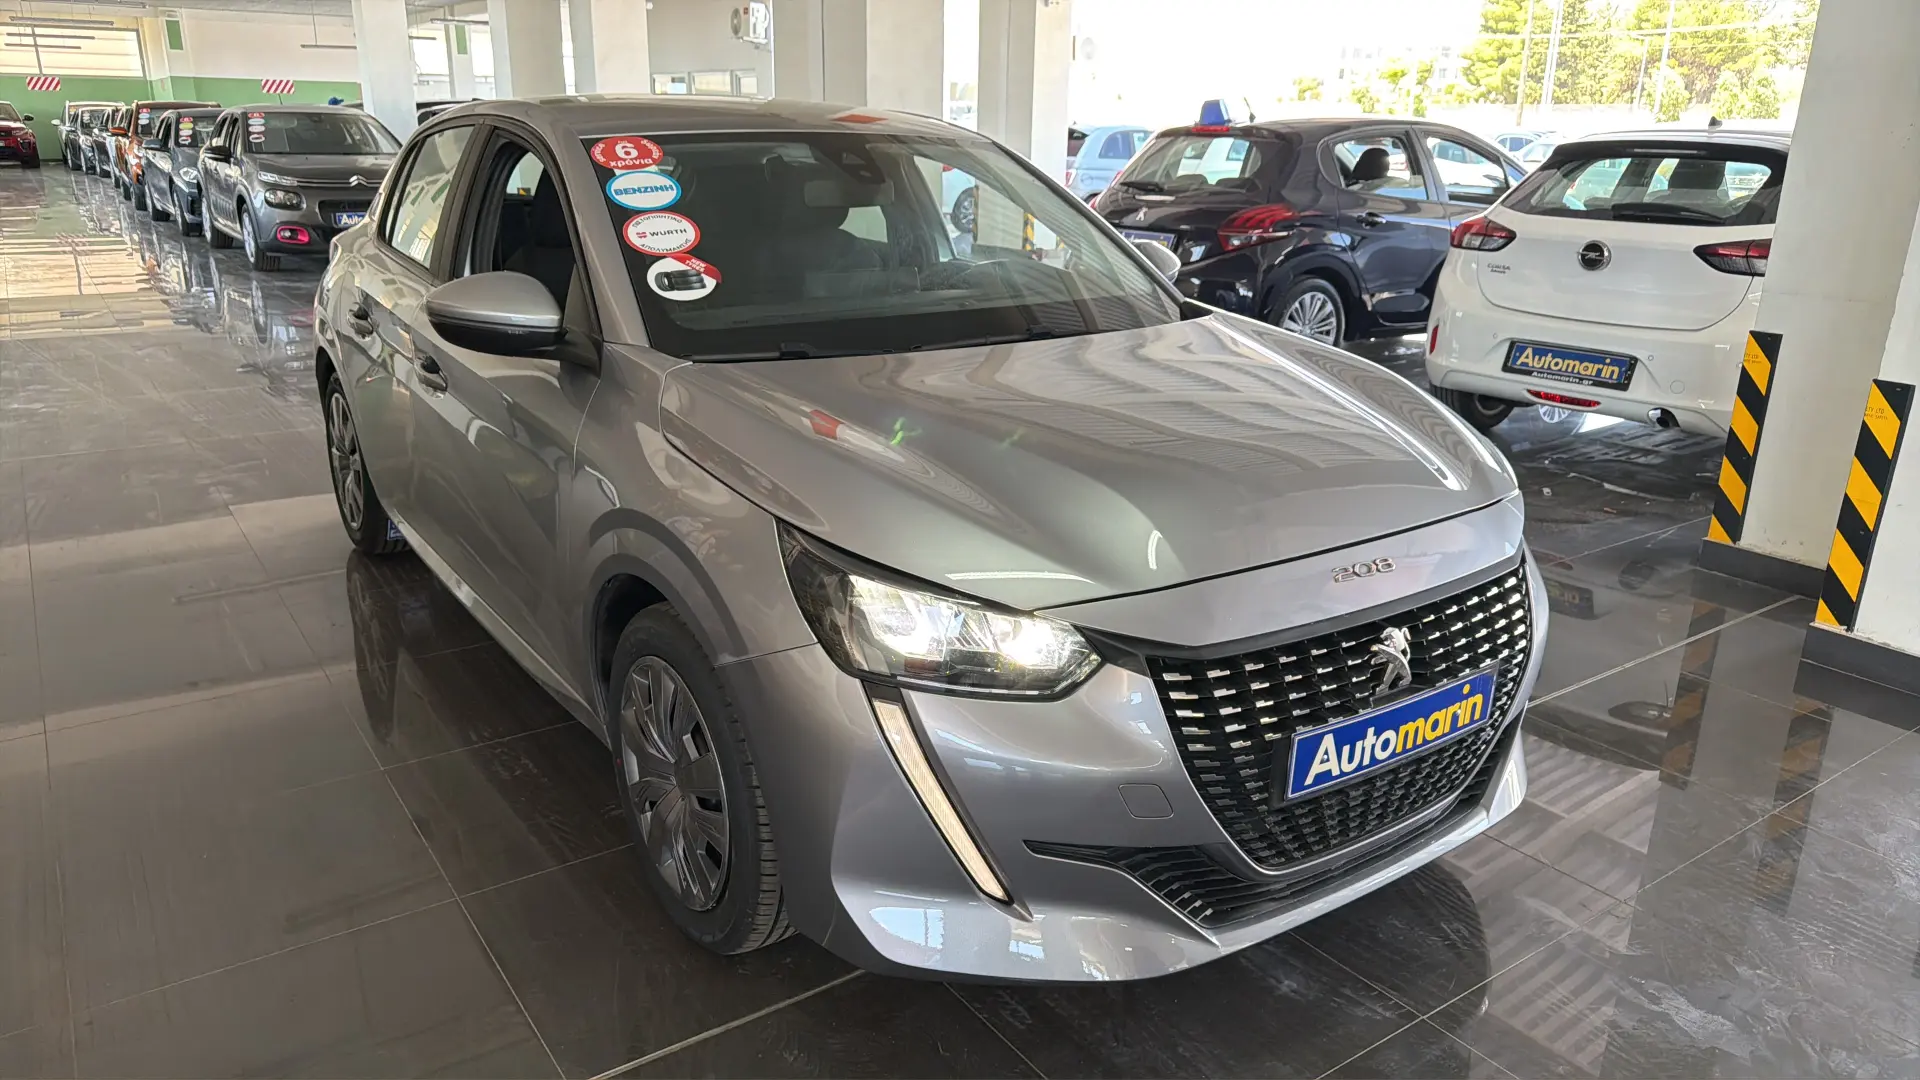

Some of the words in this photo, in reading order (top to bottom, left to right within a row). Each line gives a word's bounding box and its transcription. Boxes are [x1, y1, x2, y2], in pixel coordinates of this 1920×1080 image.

[615, 143, 639, 159] 6
[609, 158, 653, 168] χρόνια
[690, 258, 707, 268] NEW
[1516, 347, 1620, 380] Automarin
[1531, 371, 1594, 386] Automarin.gr
[1332, 556, 1397, 583] 208
[1303, 683, 1484, 787] Automarin
